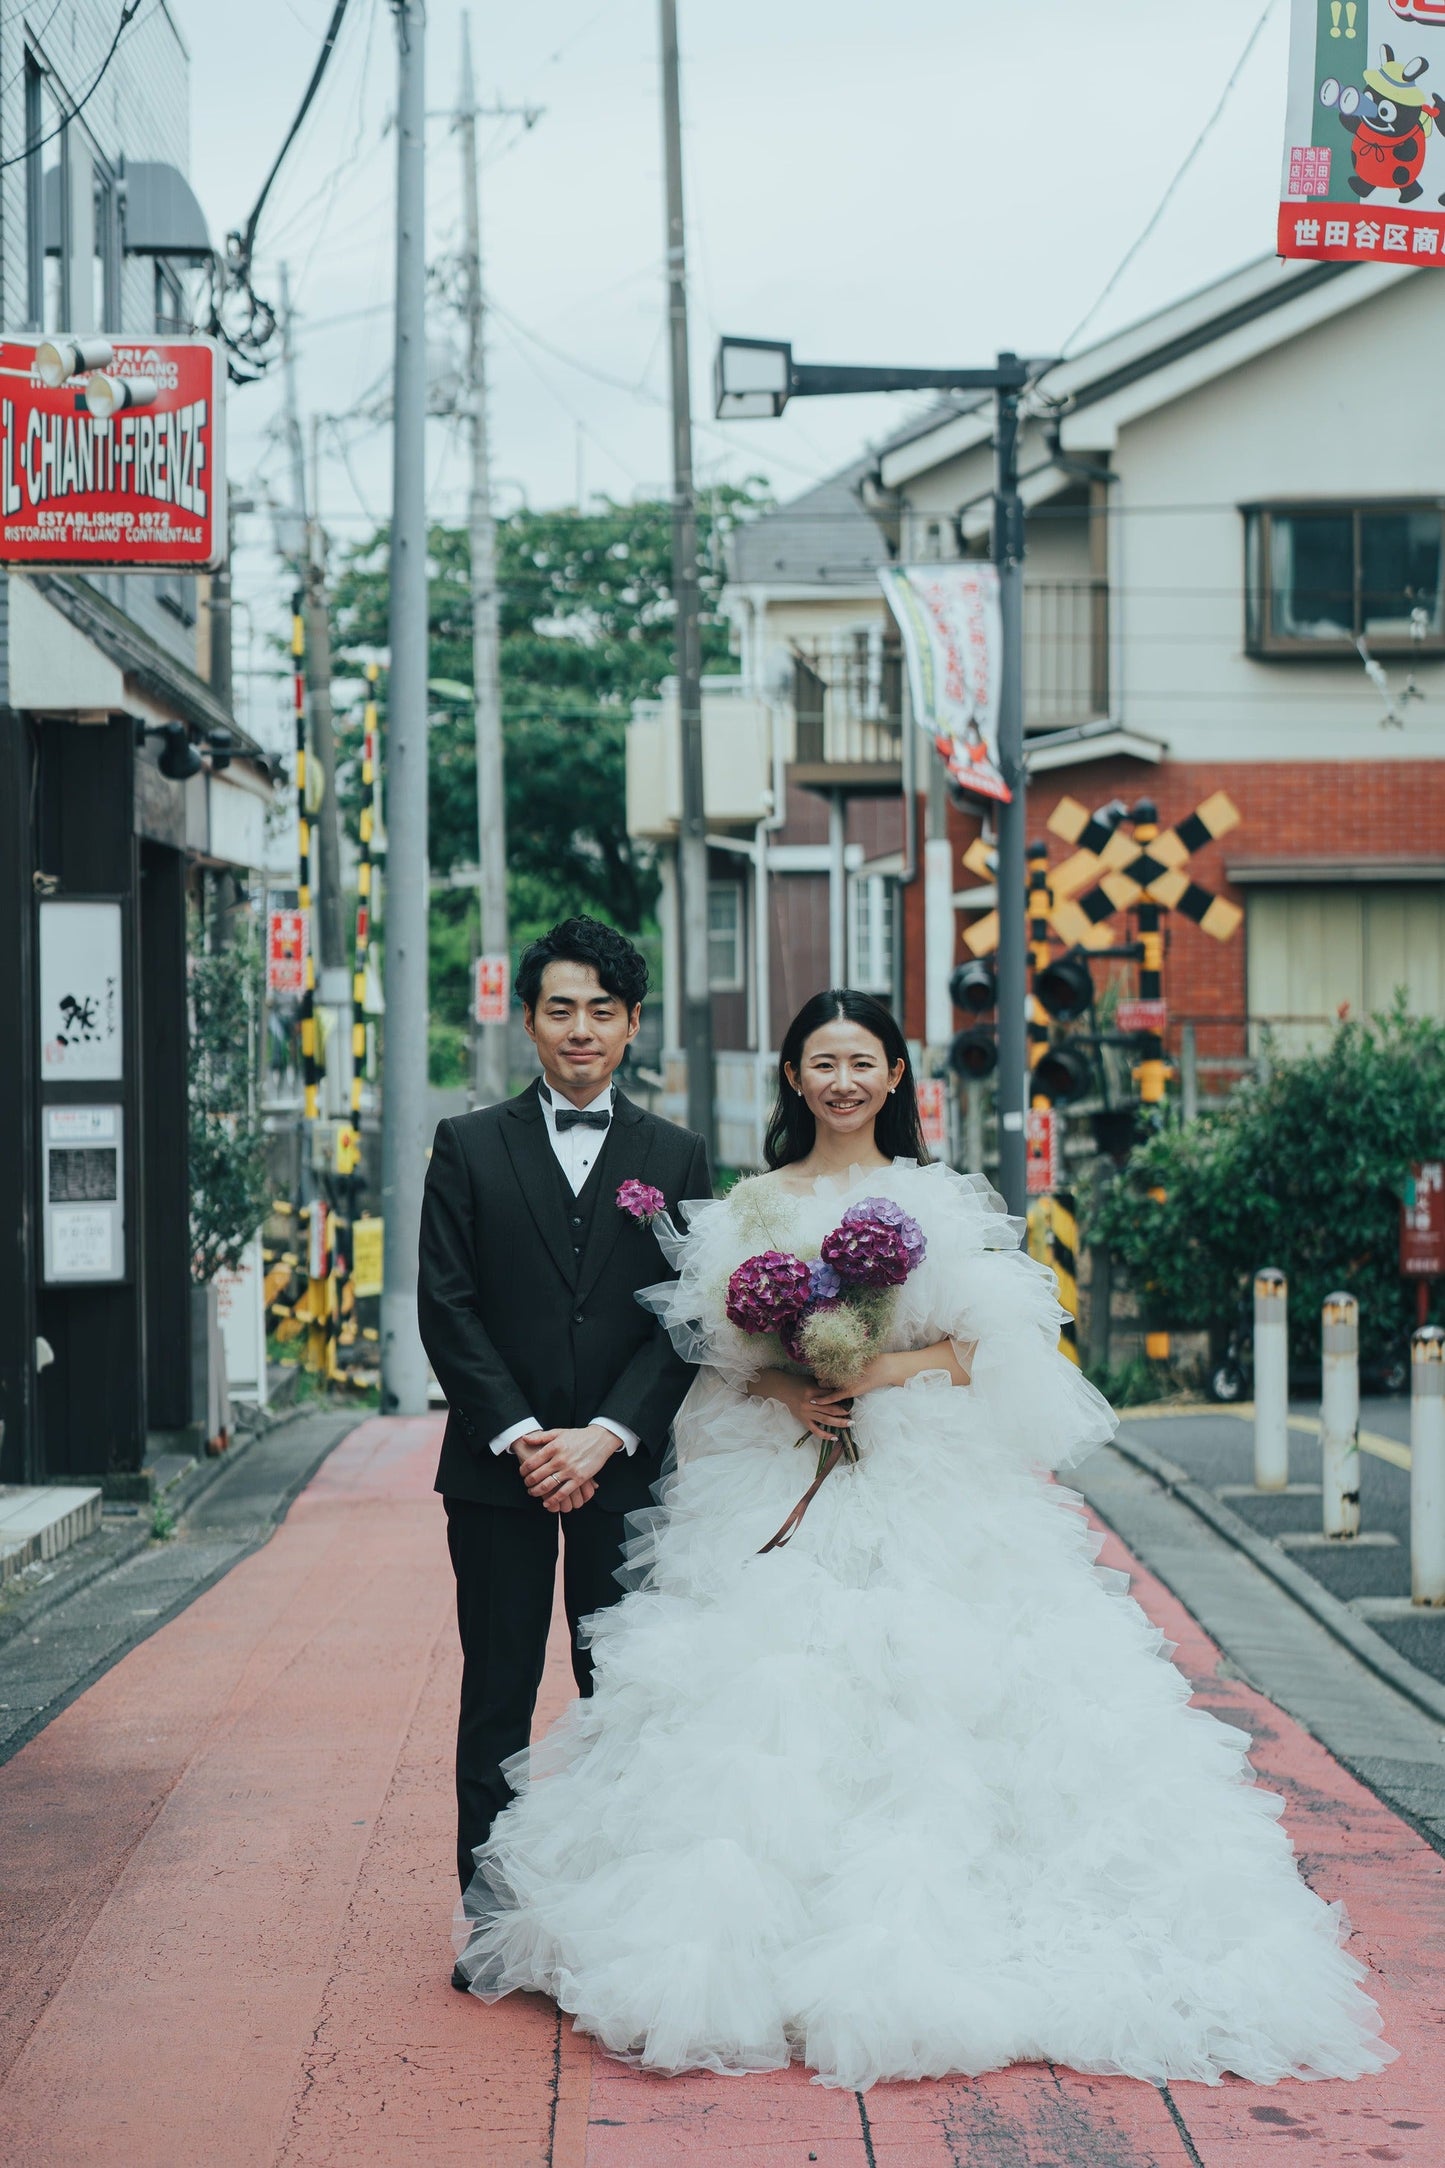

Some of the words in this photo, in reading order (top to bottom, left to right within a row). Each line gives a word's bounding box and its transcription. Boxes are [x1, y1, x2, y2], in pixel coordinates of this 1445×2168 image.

[1303, 149, 1316, 193] 地元の
[1317, 149, 1330, 194] 世田谷
[1294, 219, 1445, 255] 世田谷区商
[4, 526, 67, 542] RISTORANTE
[72, 527, 120, 543] ITALIANO
[125, 527, 203, 544] CONTINENTALE
[37, 511, 135, 527] ESTABLISHED
[138, 512, 171, 528] 1972
